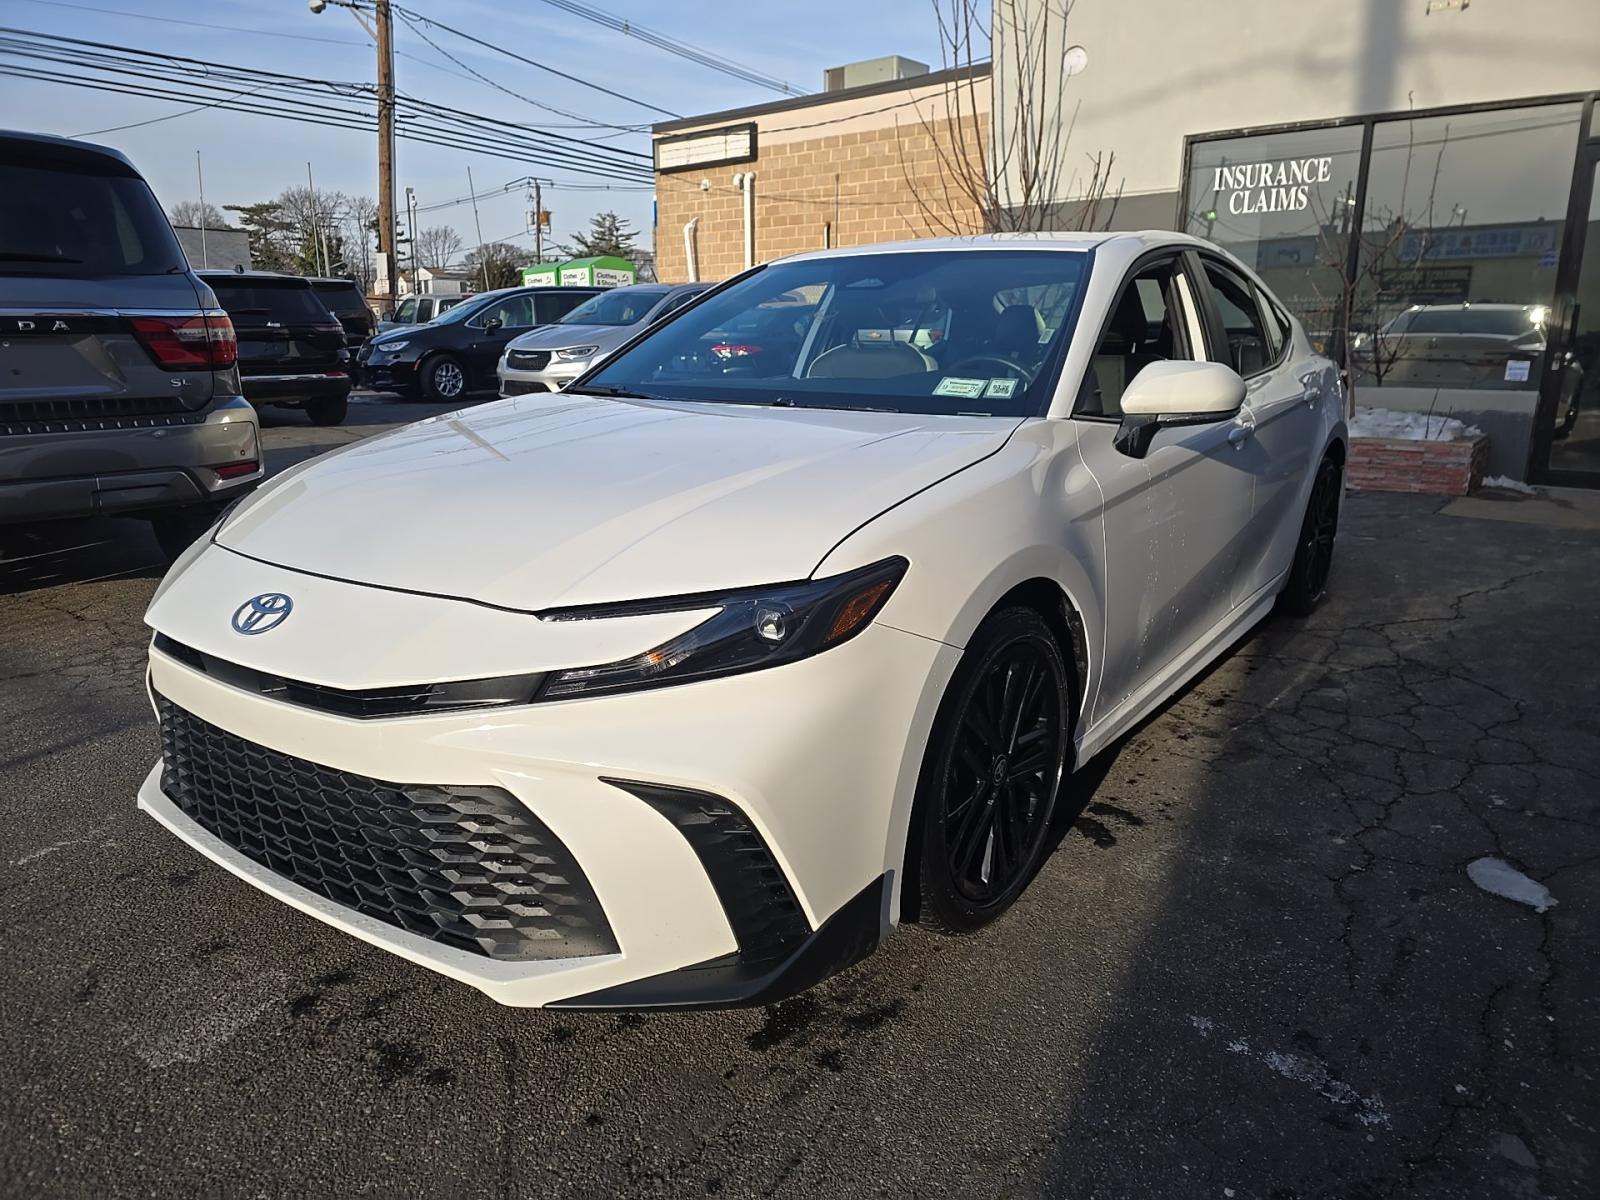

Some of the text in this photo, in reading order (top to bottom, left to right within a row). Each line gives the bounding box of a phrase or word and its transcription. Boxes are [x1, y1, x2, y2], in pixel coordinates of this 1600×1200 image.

[1213, 157, 1332, 191] INSURANCE
[1229, 185, 1309, 215] CLAIMS
[597, 272, 617, 280] Clothes
